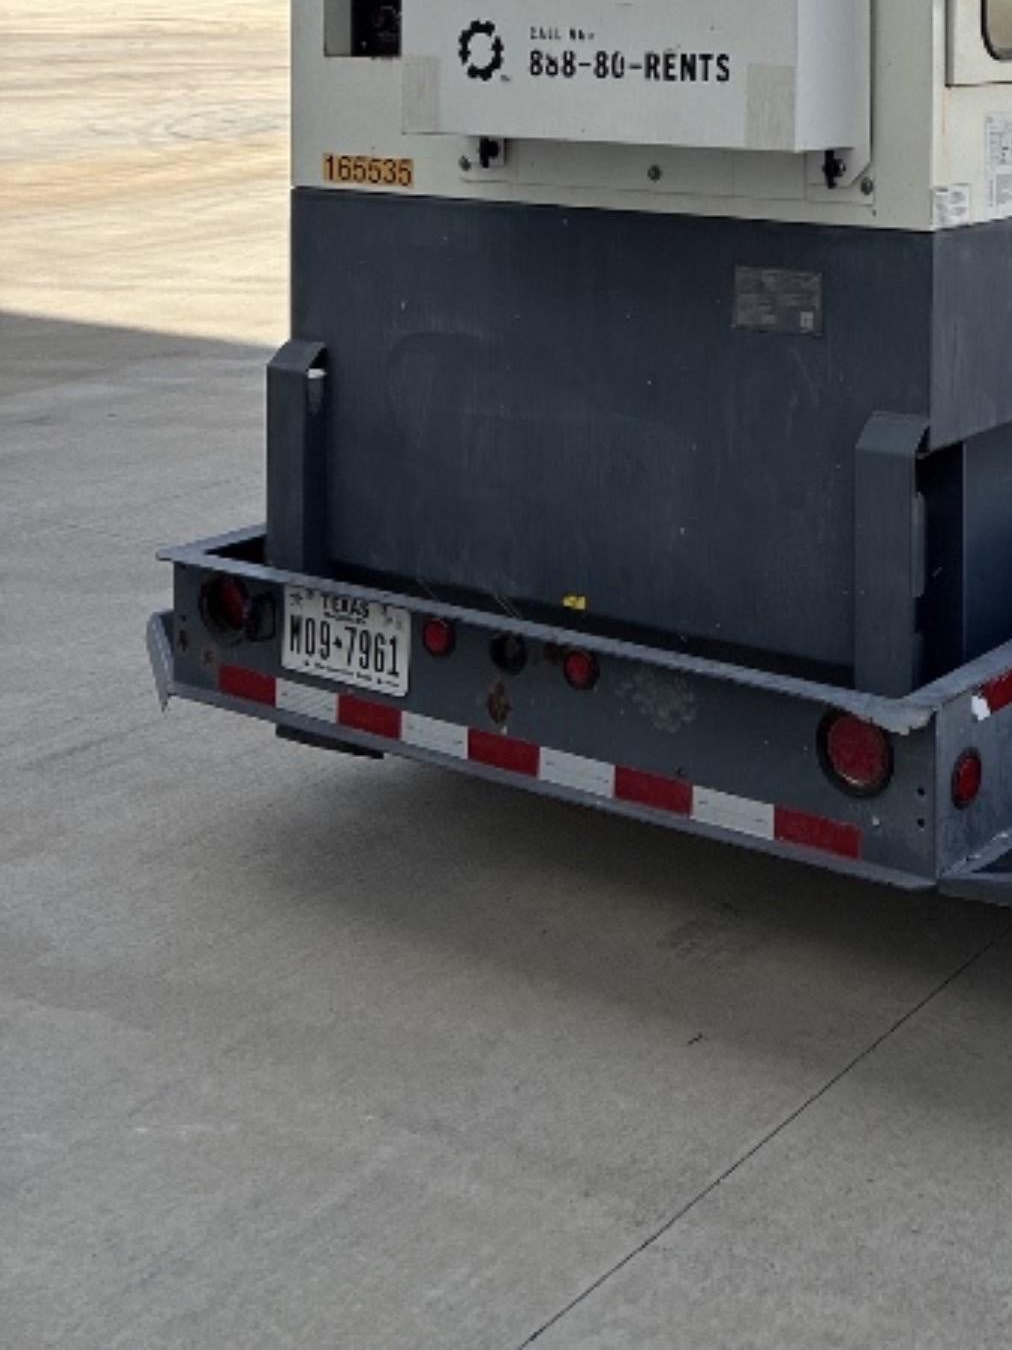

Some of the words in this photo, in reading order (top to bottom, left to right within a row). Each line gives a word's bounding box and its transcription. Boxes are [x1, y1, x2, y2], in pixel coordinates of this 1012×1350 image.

[529, 49, 730, 82] 888-80-RENTS
[325, 154, 412, 187] 165535
[321, 593, 370, 619] TEXAS
